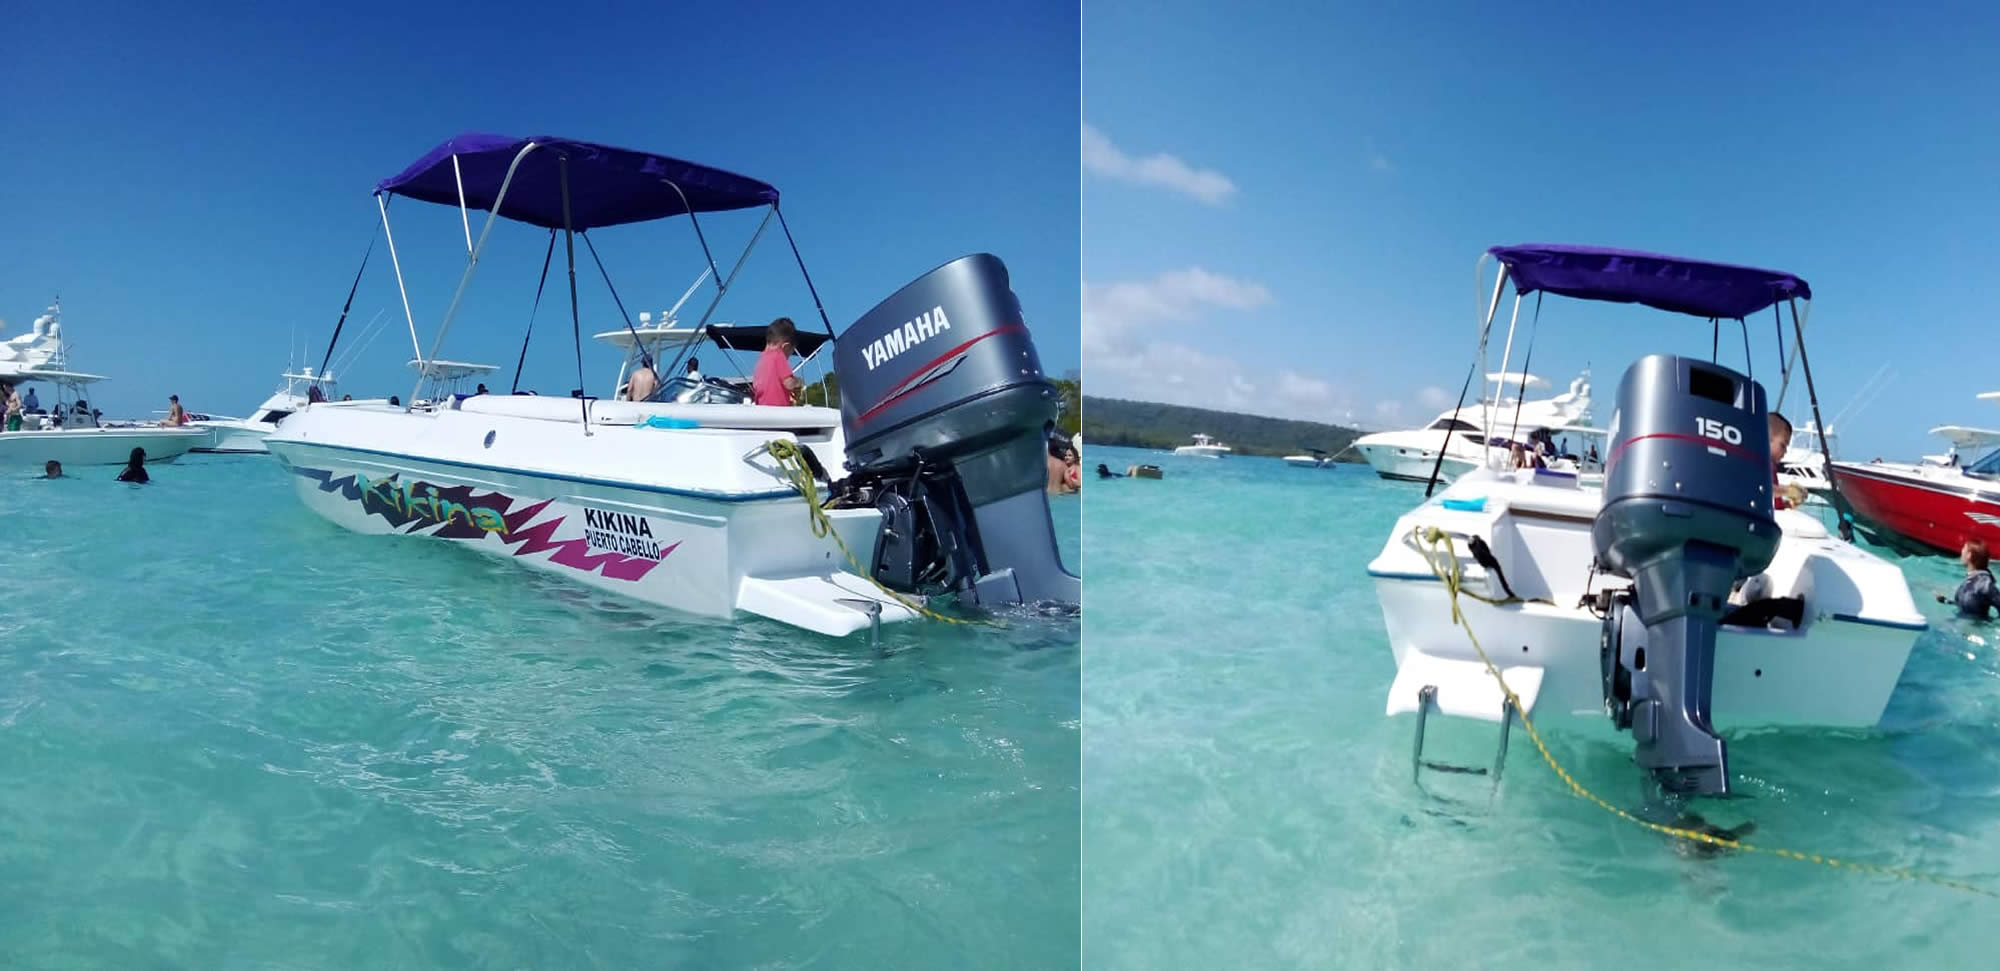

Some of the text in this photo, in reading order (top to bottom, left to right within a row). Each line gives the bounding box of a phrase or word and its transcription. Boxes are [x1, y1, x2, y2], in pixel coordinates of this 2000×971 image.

[861, 305, 951, 371] YAMAHA
[1695, 416, 1742, 446] 150
[357, 471, 510, 536] Kikina
[584, 508, 654, 540] KIKINA
[584, 529, 660, 561] PUERTO CABELLO
